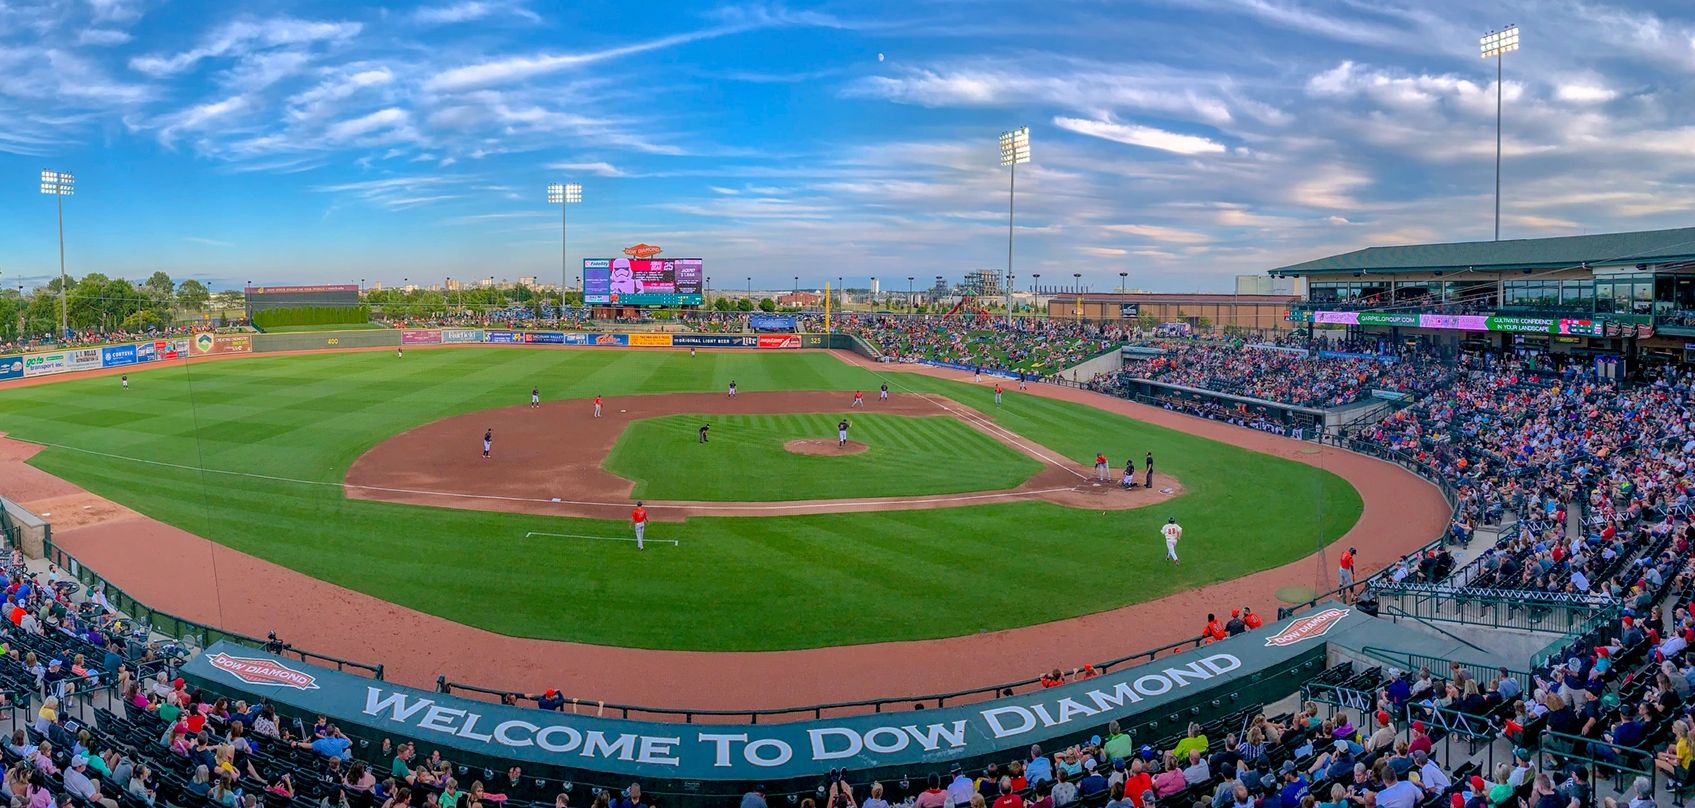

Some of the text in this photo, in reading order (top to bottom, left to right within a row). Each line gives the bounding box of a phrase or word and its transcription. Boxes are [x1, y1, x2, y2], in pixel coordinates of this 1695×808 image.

[742, 336, 757, 346] Lite
[112, 350, 134, 358] CORTEVA
[30, 362, 54, 371] transport
[1274, 610, 1340, 644] DOW DIAMOND
[216, 656, 308, 685] DOW DIAMOND
[362, 686, 681, 767] WELCOME
[980, 653, 1242, 739] DIAMOND
